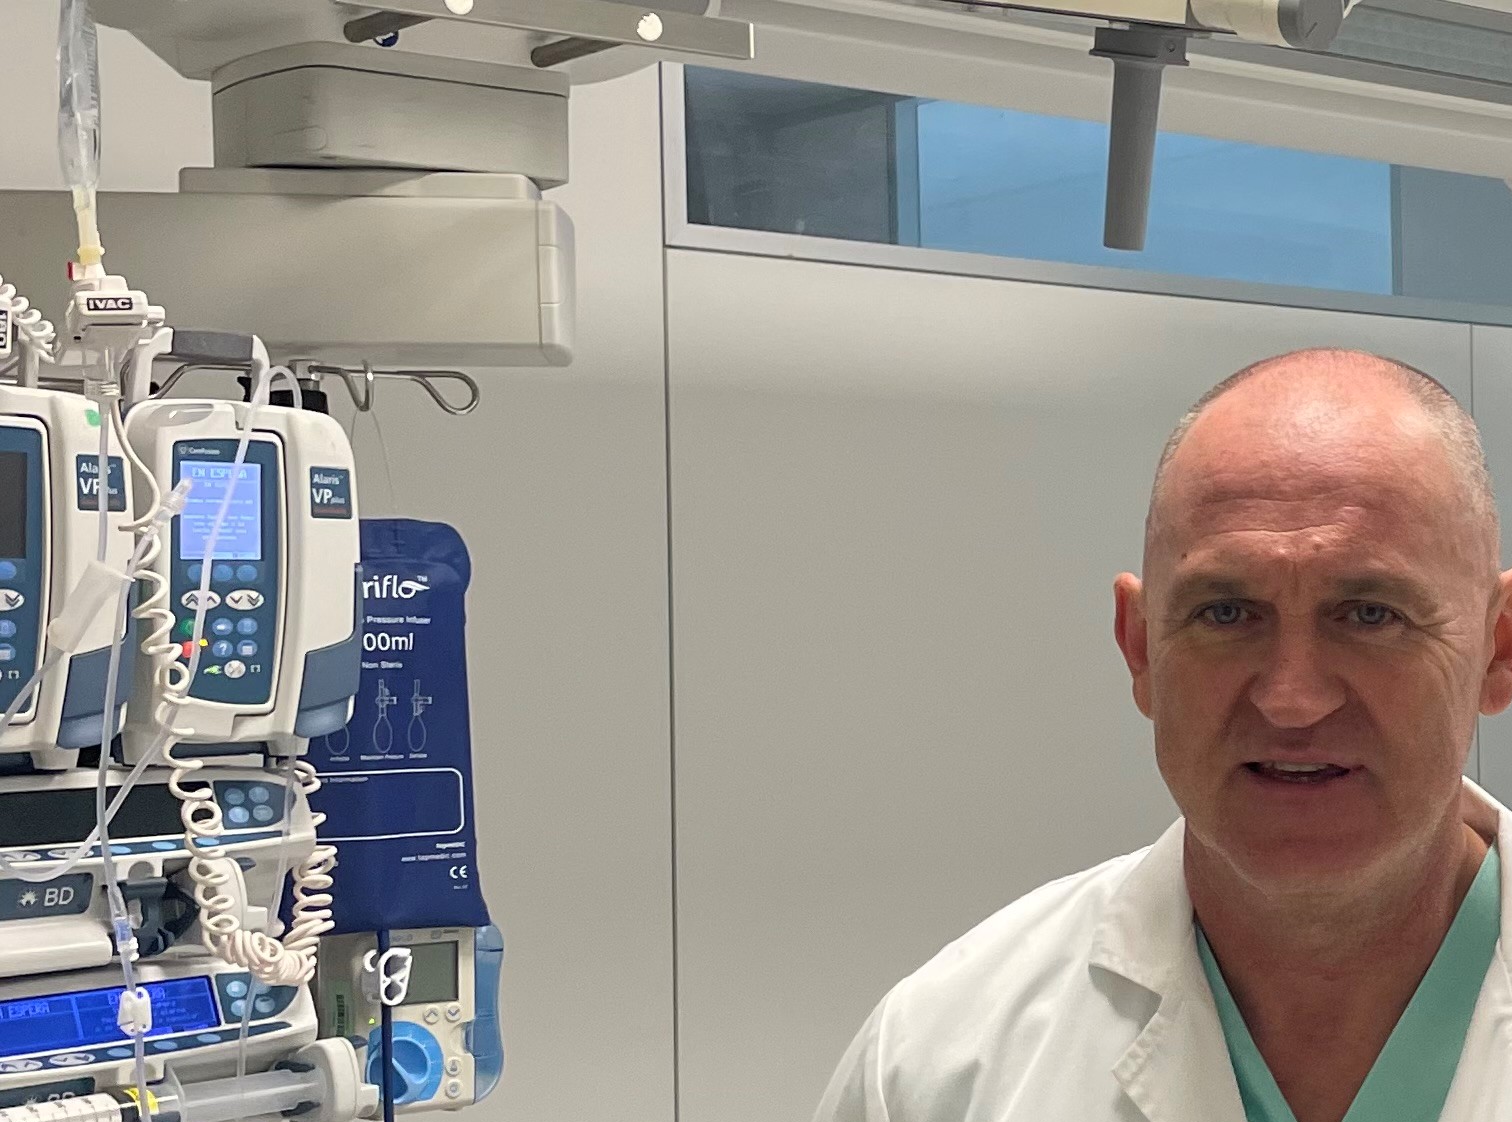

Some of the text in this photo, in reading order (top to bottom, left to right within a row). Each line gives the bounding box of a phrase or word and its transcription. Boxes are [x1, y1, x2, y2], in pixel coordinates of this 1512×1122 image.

[88, 299, 132, 309] IVAC
[312, 473, 340, 485] Alaris
[366, 615, 404, 624] Pressure
[44, 887, 74, 906] BD
